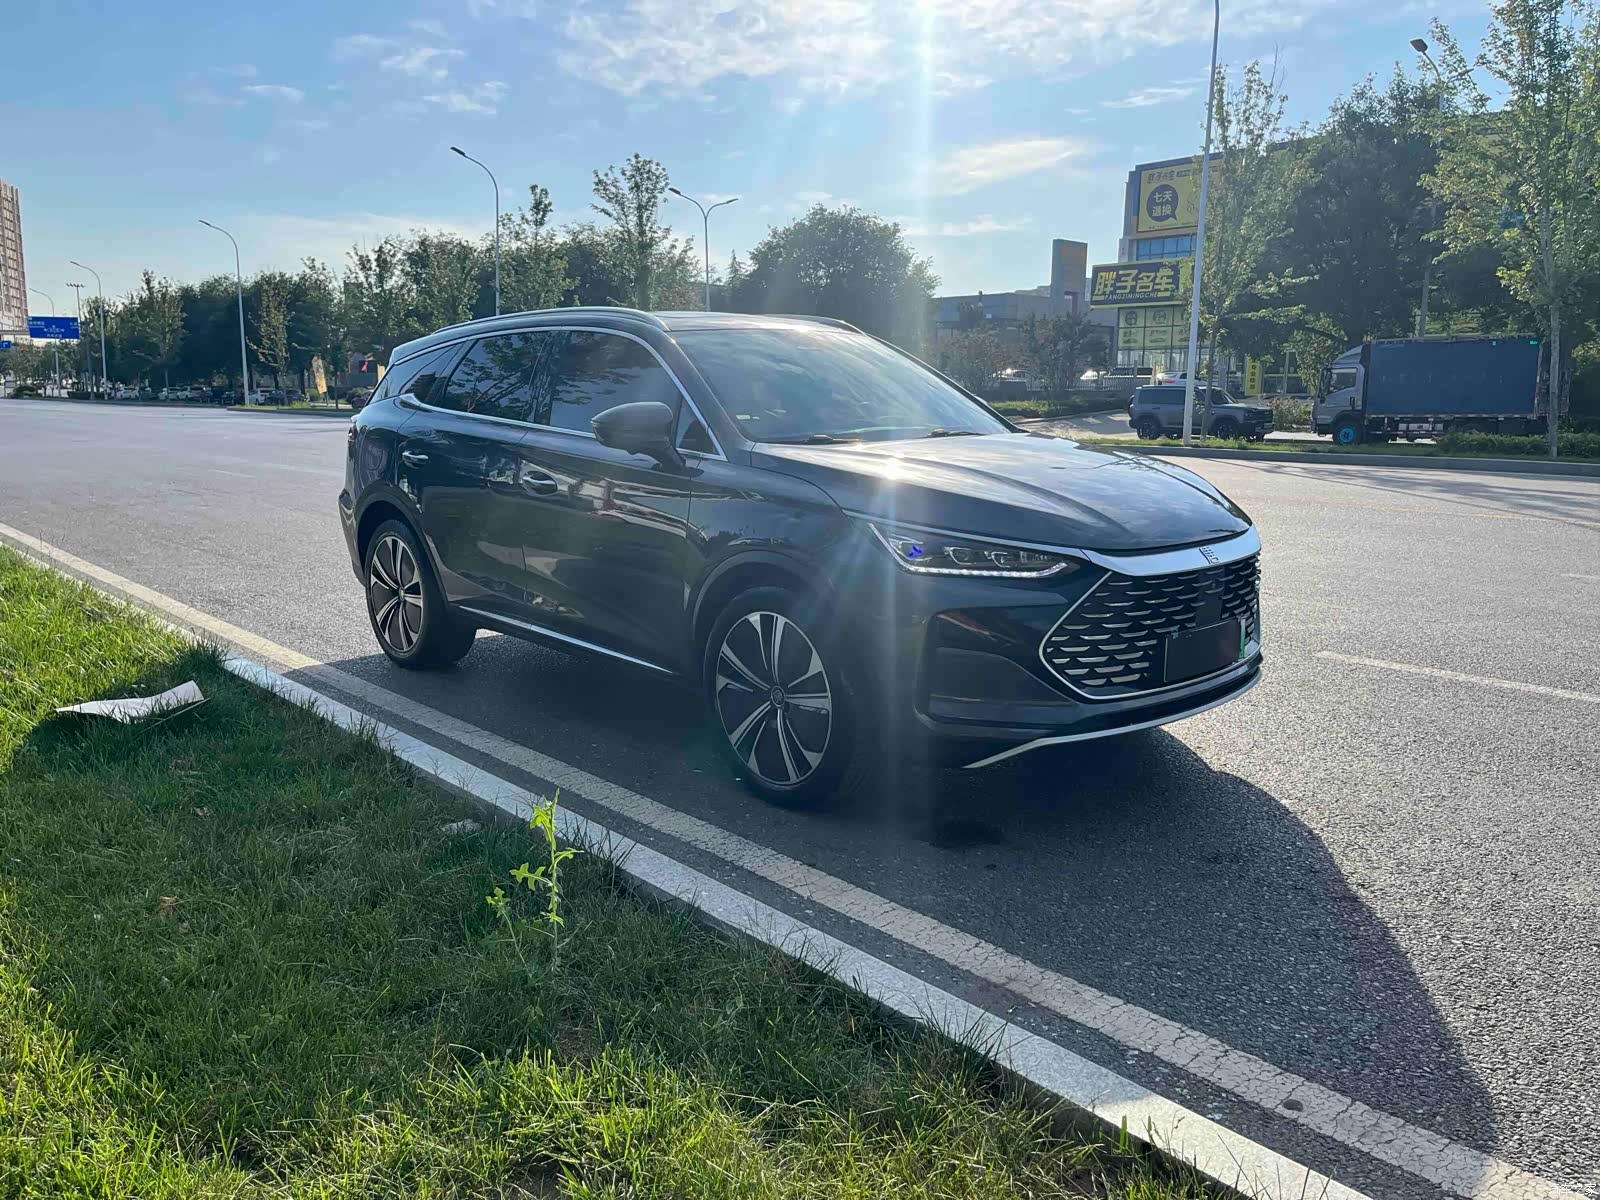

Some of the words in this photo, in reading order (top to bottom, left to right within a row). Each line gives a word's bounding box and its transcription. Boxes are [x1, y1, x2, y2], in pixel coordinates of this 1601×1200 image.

[1153, 190, 1172, 203] 七天
[1094, 267, 1175, 295] 胖子名车
